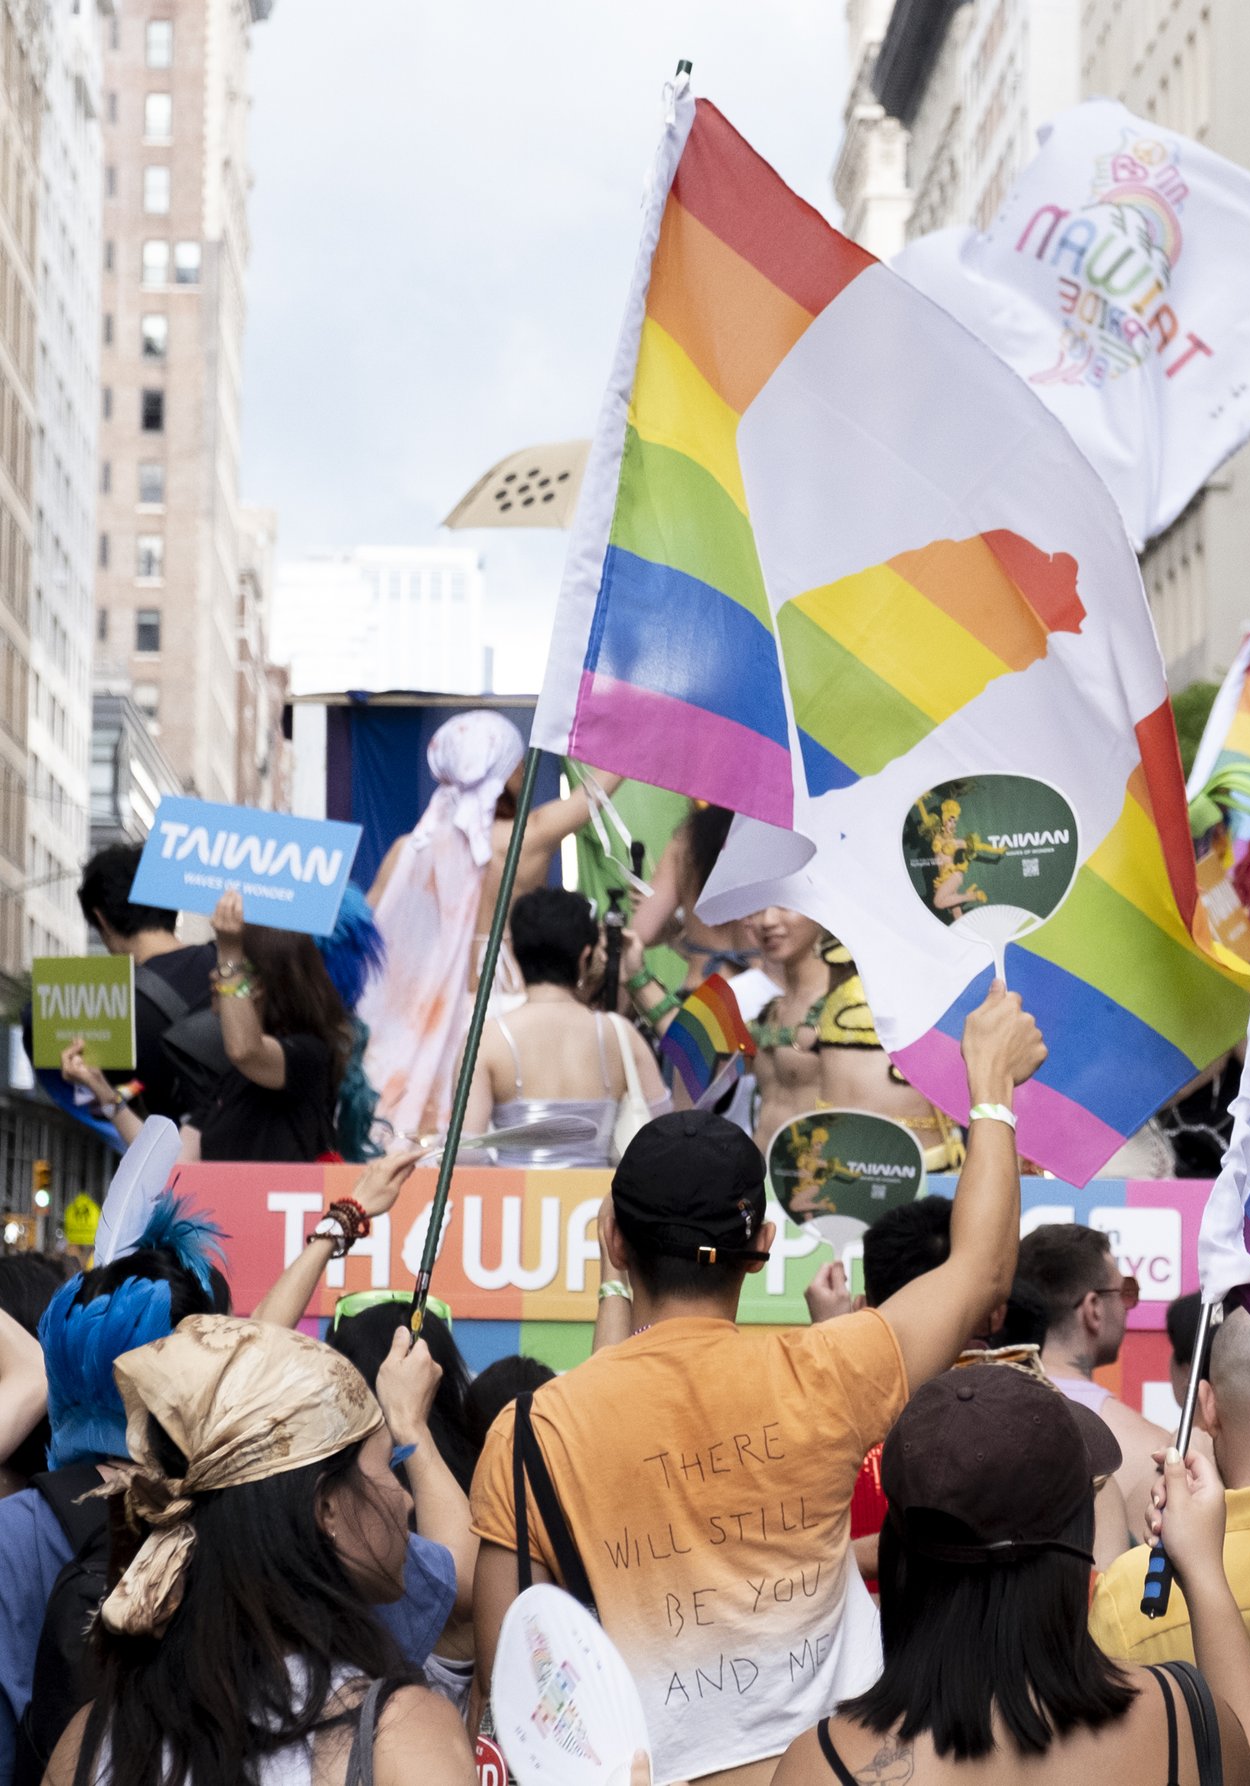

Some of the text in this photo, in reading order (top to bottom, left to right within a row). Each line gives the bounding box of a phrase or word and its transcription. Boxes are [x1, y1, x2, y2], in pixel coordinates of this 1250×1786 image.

[158, 820, 343, 887] TAIWAN
[987, 829, 1069, 849] TAIWAN
[184, 870, 224, 890] WAVES
[243, 882, 294, 902] WONDER
[37, 983, 127, 1020] TAIWAN
[847, 1161, 916, 1179] TAIWAN
[1115, 1256, 1170, 1282] YC
[643, 1422, 785, 1488] THERE
[604, 1496, 819, 1569] WILL STILL
[665, 1562, 821, 1638] BE YOU
[665, 1633, 830, 1705] AND ME
